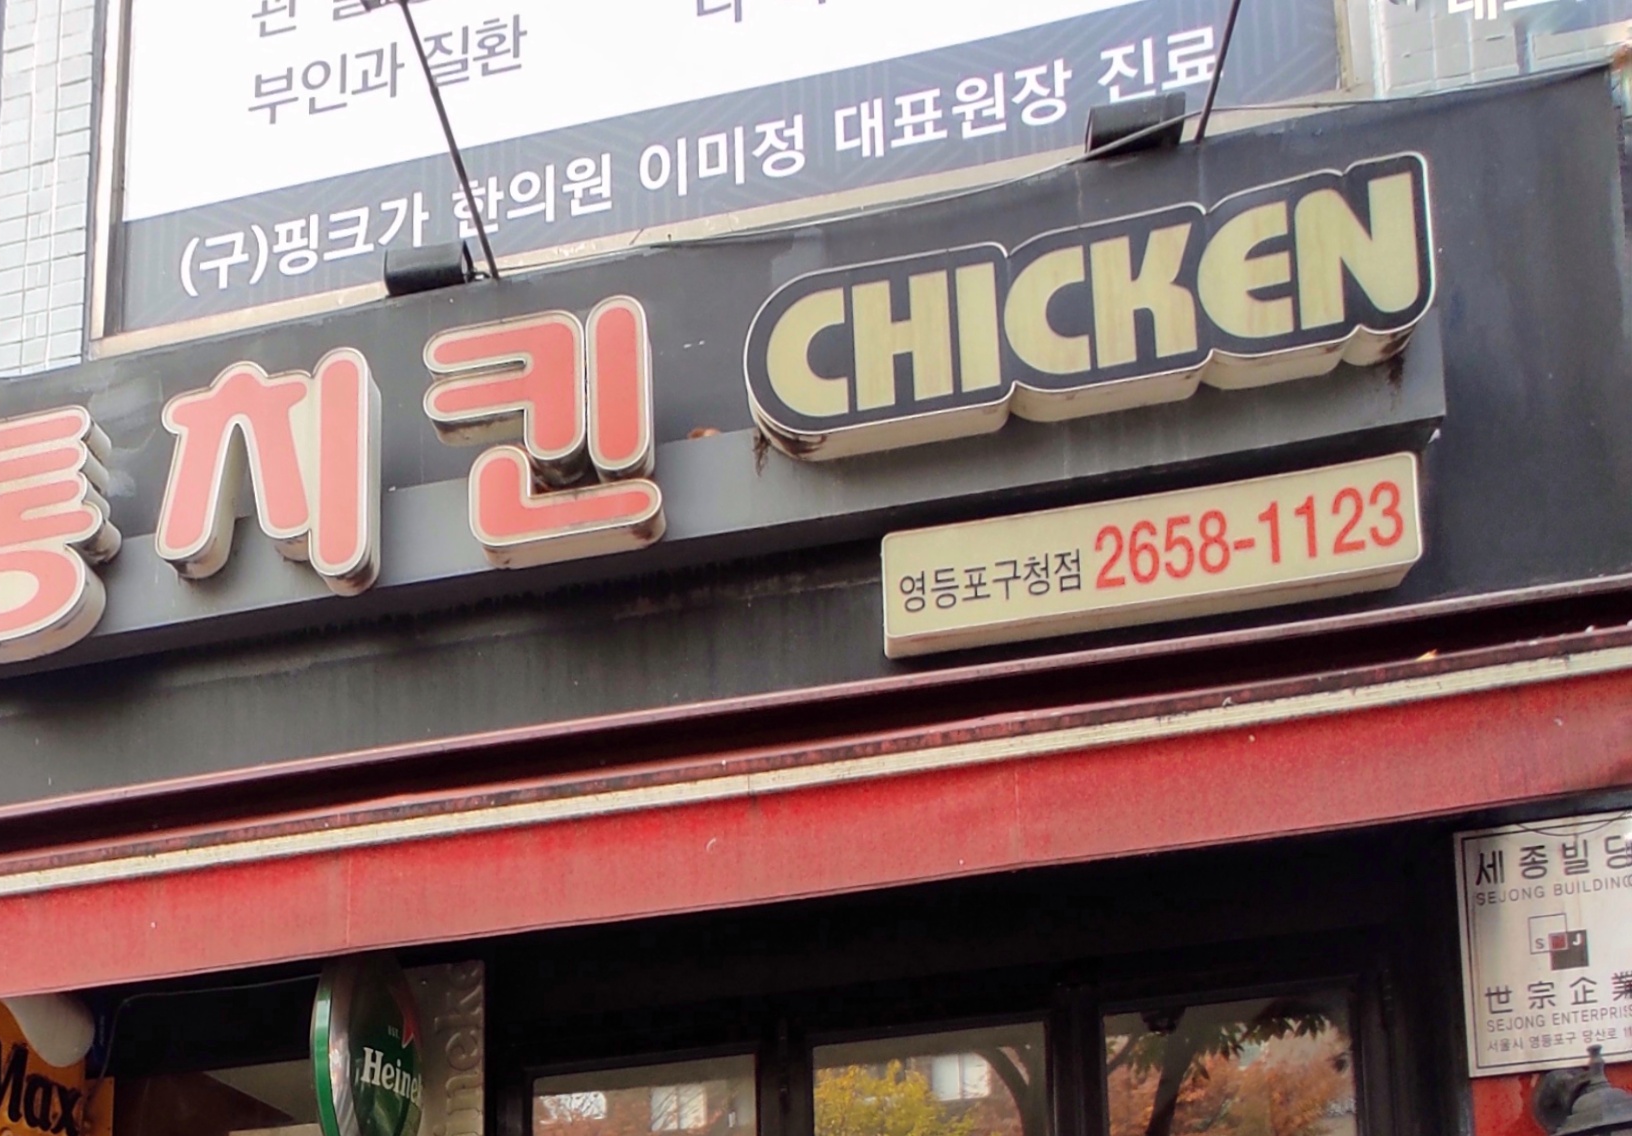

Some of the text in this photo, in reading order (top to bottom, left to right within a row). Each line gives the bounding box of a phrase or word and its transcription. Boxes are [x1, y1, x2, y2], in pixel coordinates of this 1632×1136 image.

[248, 42, 405, 124] 부인과
[424, 14, 528, 88] 질환
[180, 27, 1225, 296] (구)핑크가 한의원 이미정 대표원장 진료
[767, 172, 1421, 416] CHICKEN
[898, 480, 1405, 614] 영등포구청점 2658-1123
[1476, 885, 1546, 906] SEJONG
[1487, 1013, 1546, 1033] SEJONG
[1487, 1038, 1524, 1053] 서울시
[1529, 1031, 1576, 1049] 영등포구
[1582, 1028, 1618, 1043] 당산로
